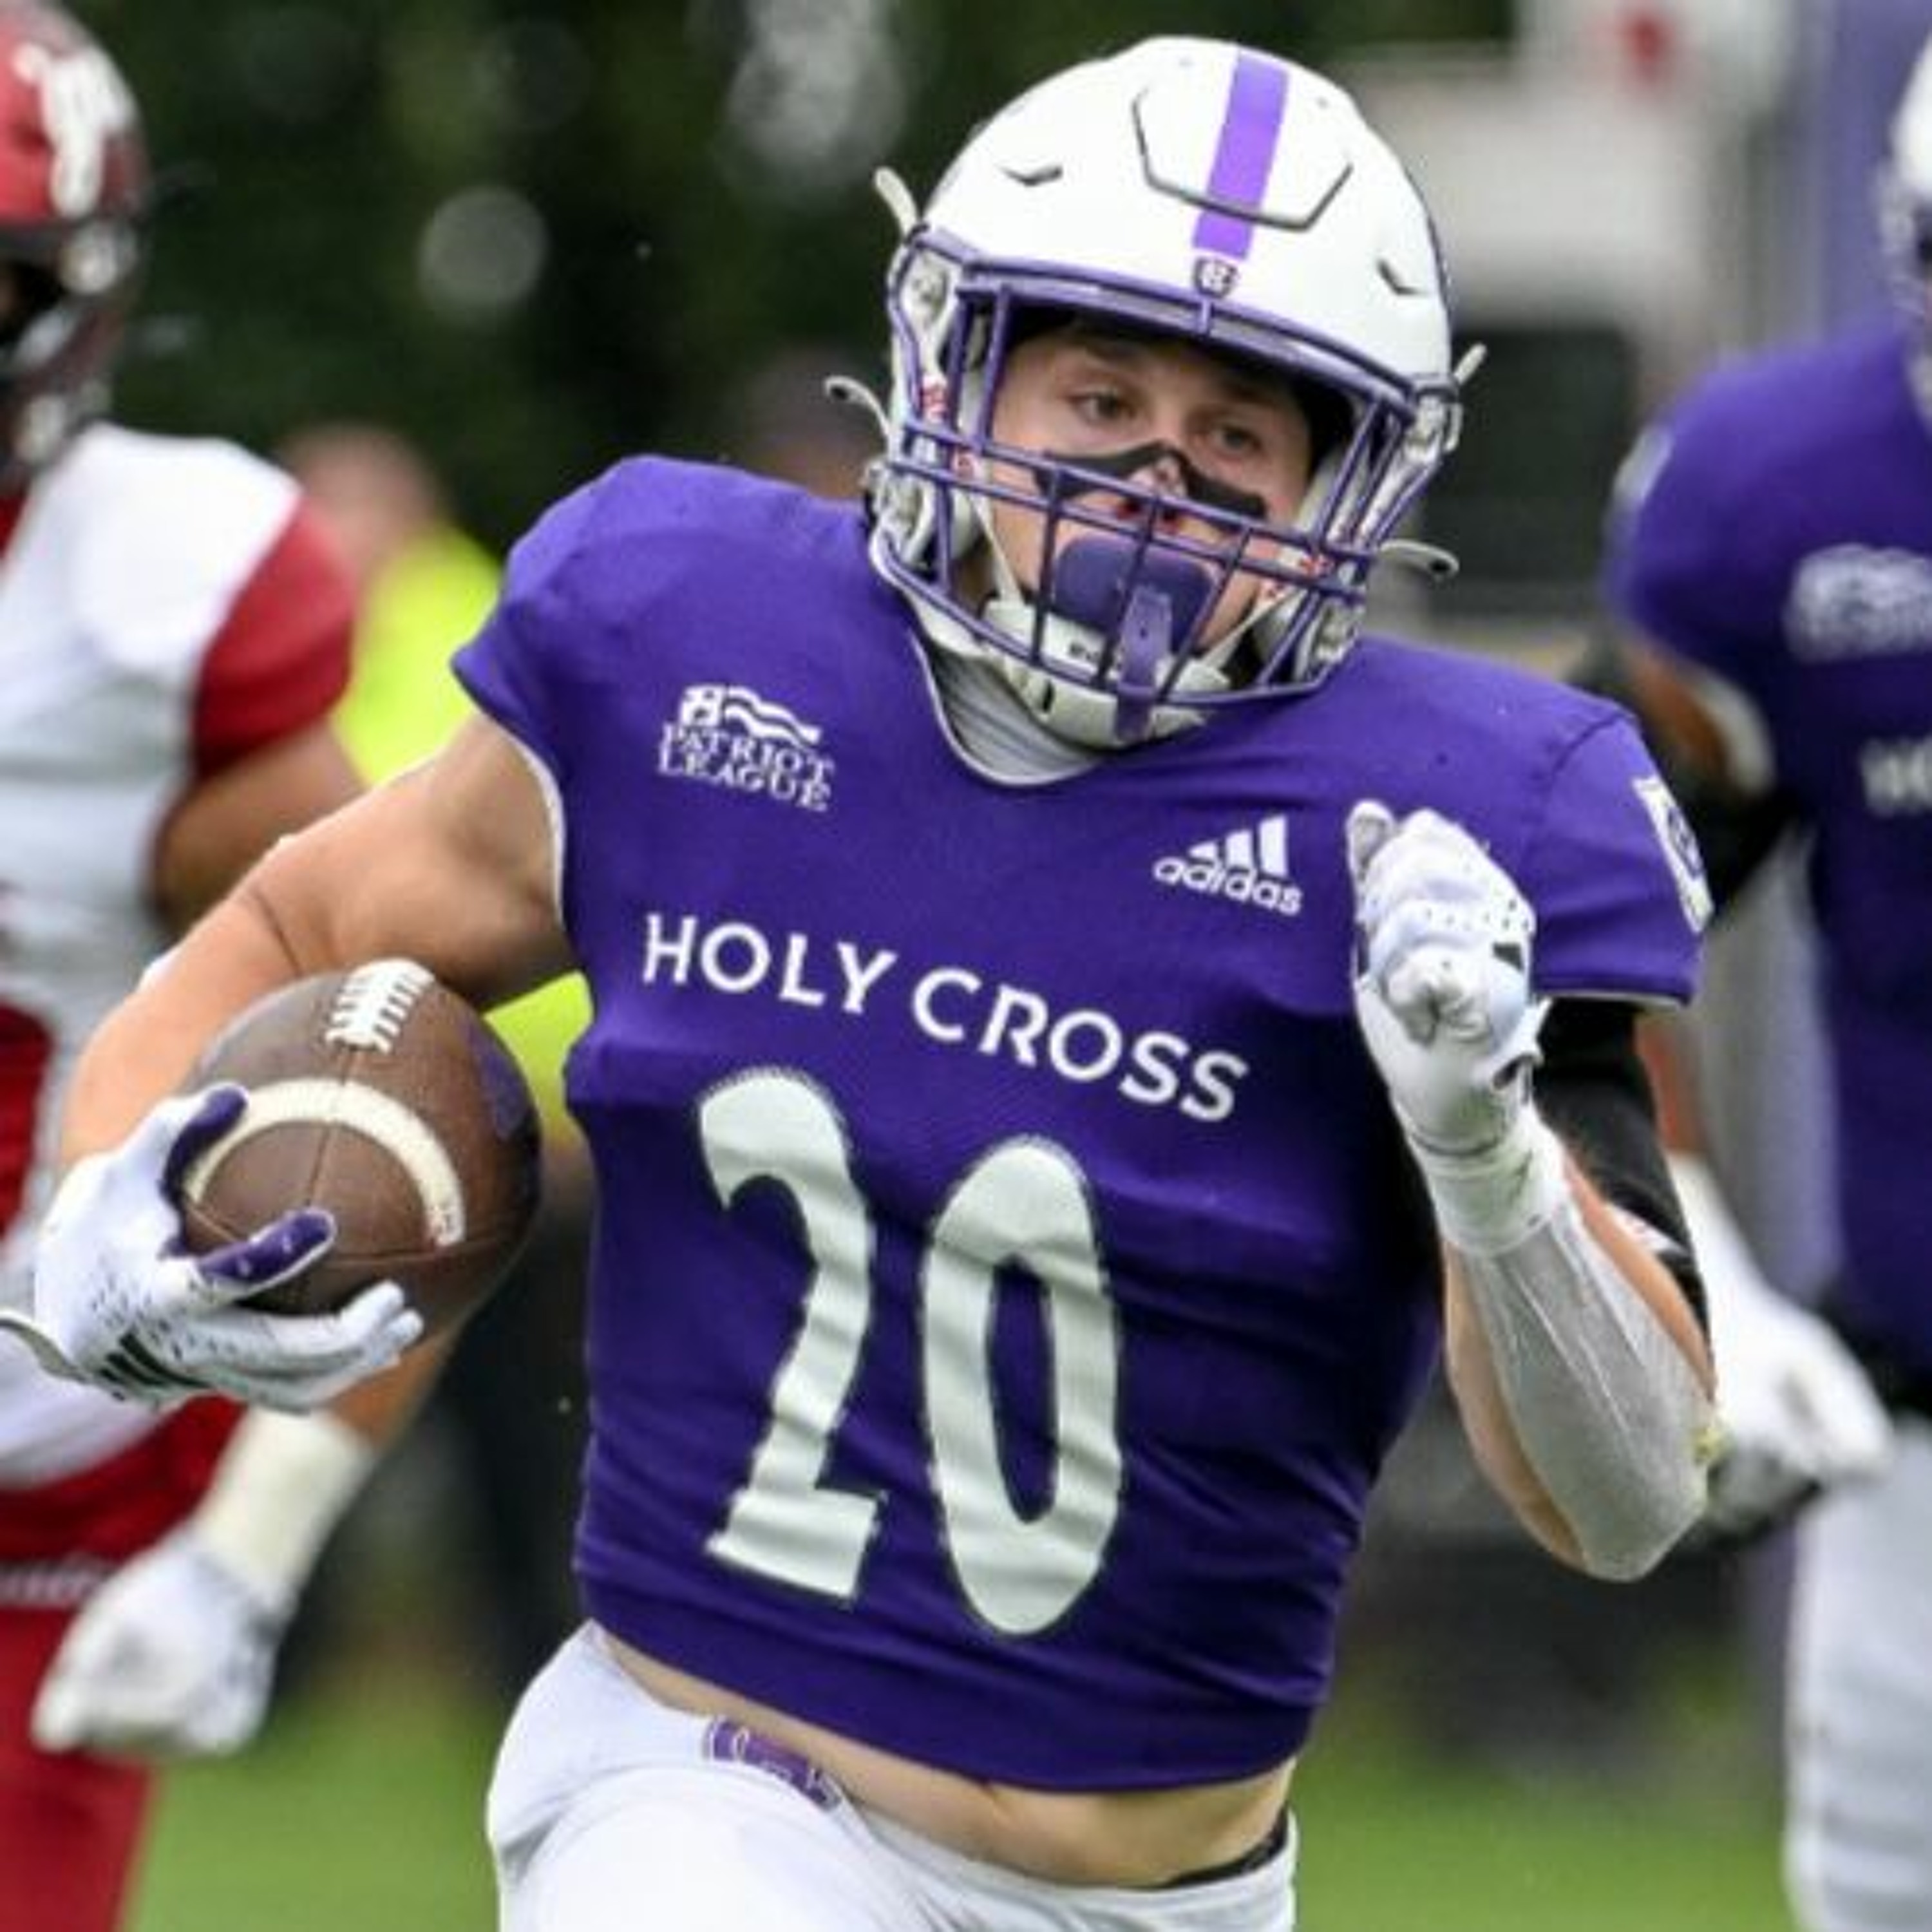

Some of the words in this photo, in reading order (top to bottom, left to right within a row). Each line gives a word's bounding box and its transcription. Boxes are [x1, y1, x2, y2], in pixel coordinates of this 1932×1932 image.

[1153, 857, 1302, 915] adidas
[644, 913, 897, 1014] HOLY
[911, 967, 1248, 1121] CROSS
[699, 1066, 1121, 1634] 20
